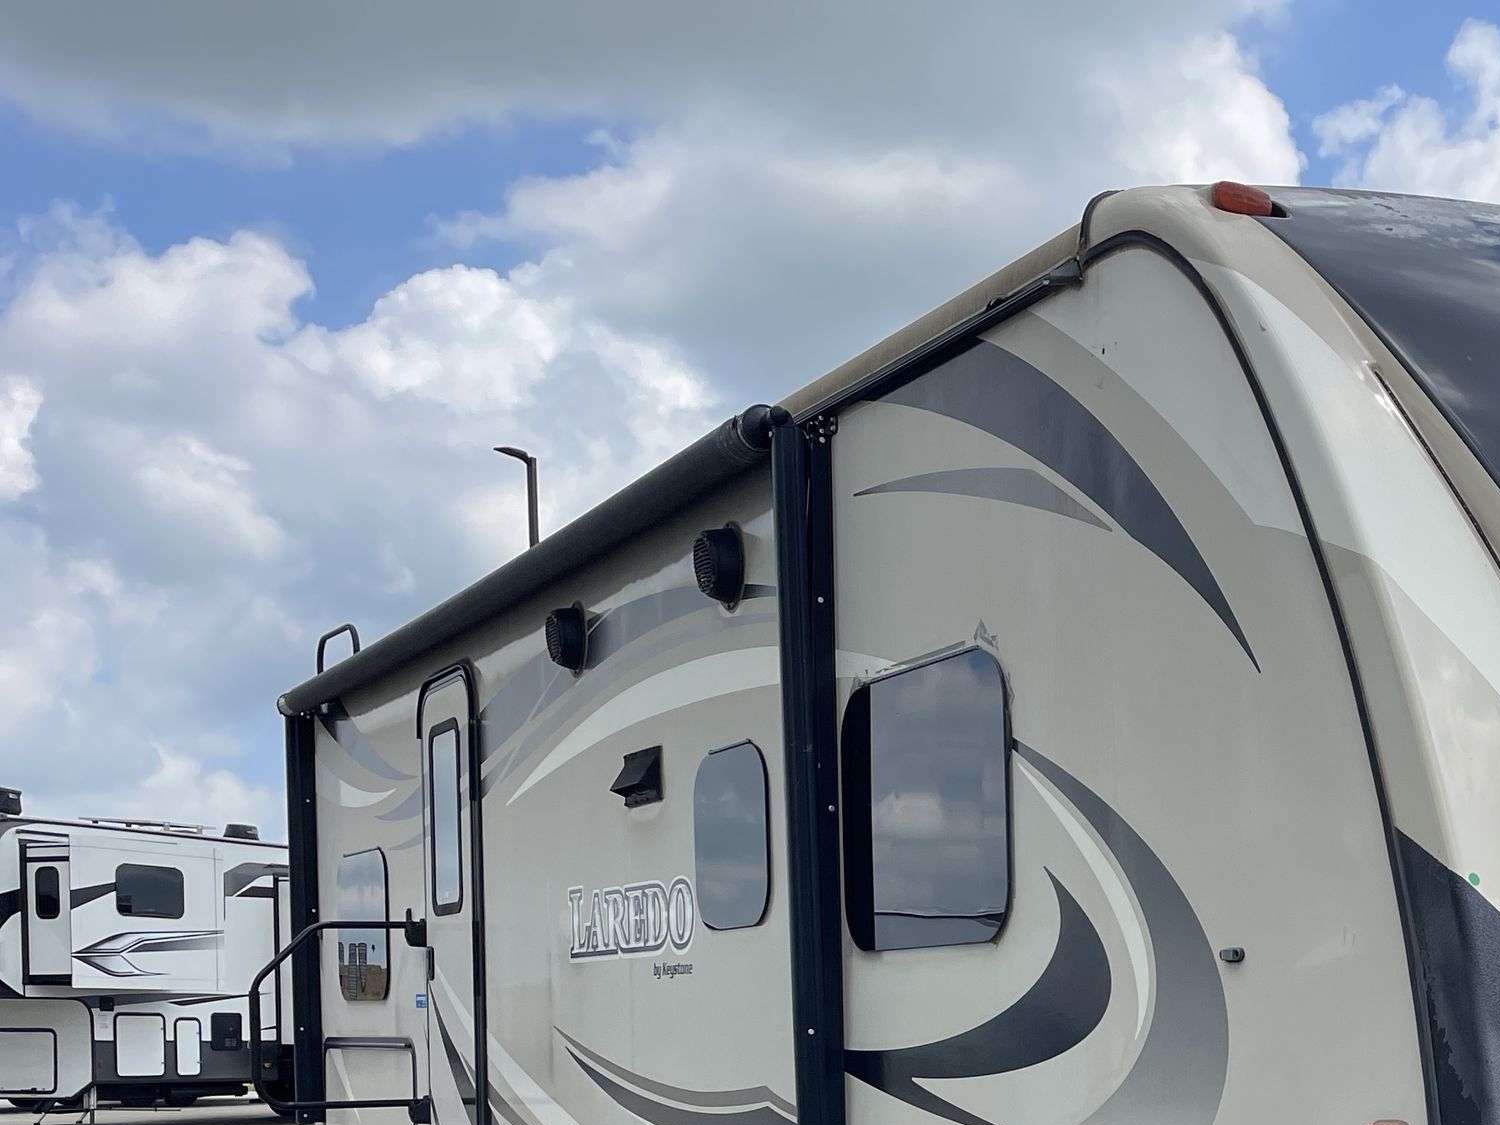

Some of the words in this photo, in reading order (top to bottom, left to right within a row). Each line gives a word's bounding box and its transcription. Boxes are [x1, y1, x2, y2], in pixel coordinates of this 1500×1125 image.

[568, 875, 695, 963] LAREDO
[653, 963, 662, 980] by
[662, 962, 693, 979] Keystone
